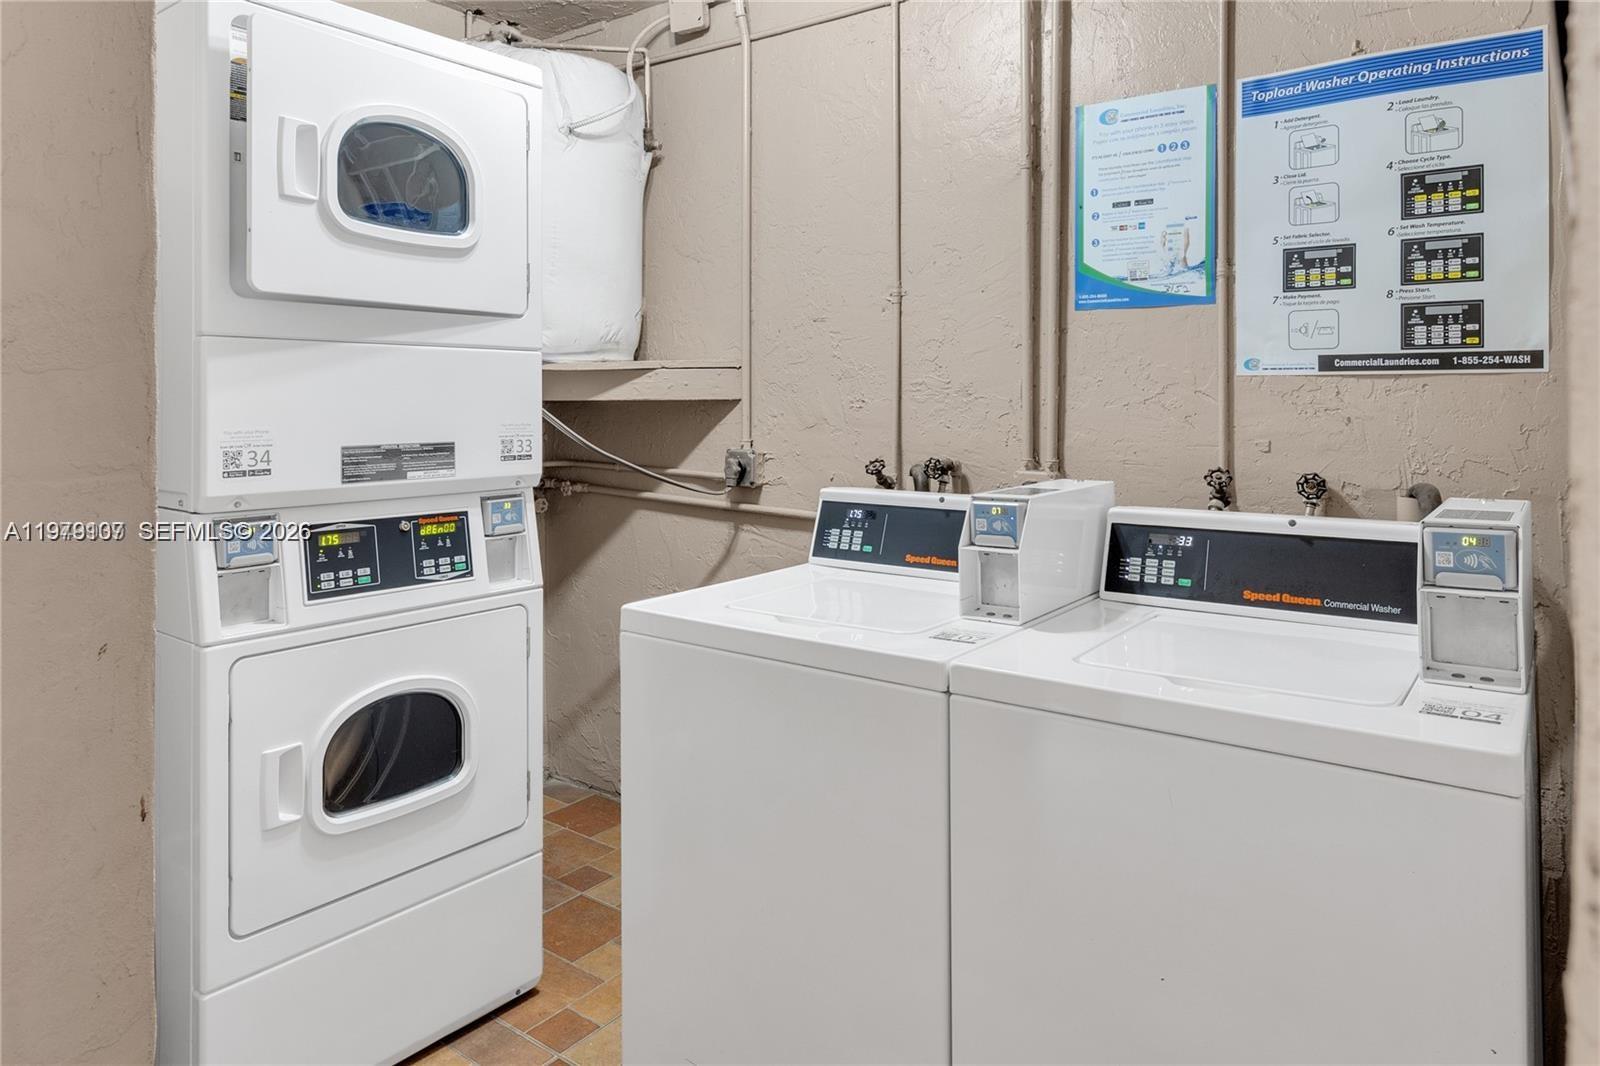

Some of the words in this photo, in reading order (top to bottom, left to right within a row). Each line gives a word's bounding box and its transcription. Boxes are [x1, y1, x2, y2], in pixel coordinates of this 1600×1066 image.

[1250, 83, 1303, 102] Topload
[1305, 75, 1356, 92] Washer
[1358, 62, 1432, 84] Operating
[1436, 48, 1530, 69] Instructions
[1386, 102, 1394, 112] 2
[1274, 120, 1278, 129] 1
[1386, 161, 1393, 170] 4
[1273, 176, 1279, 184] 3
[1388, 227, 1395, 236] 6
[1272, 236, 1279, 245] 5
[1386, 290, 1394, 298] 8
[1272, 296, 1280, 305] 7
[1334, 357, 1439, 367] CommercialLaundries.com
[1453, 355, 1531, 365] 1-855-254-WASH
[516, 439, 532, 453] 33
[247, 450, 272, 468] 34
[992, 506, 1001, 515] 07
[1462, 536, 1476, 546] 04
[905, 554, 930, 564] Speed
[931, 556, 957, 566] Queen
[1243, 590, 1281, 602] Speed
[1282, 593, 1321, 606] Queen
[1324, 599, 1369, 611] Commercial
[1371, 604, 1402, 615] Washer
[1462, 710, 1501, 721] 04
